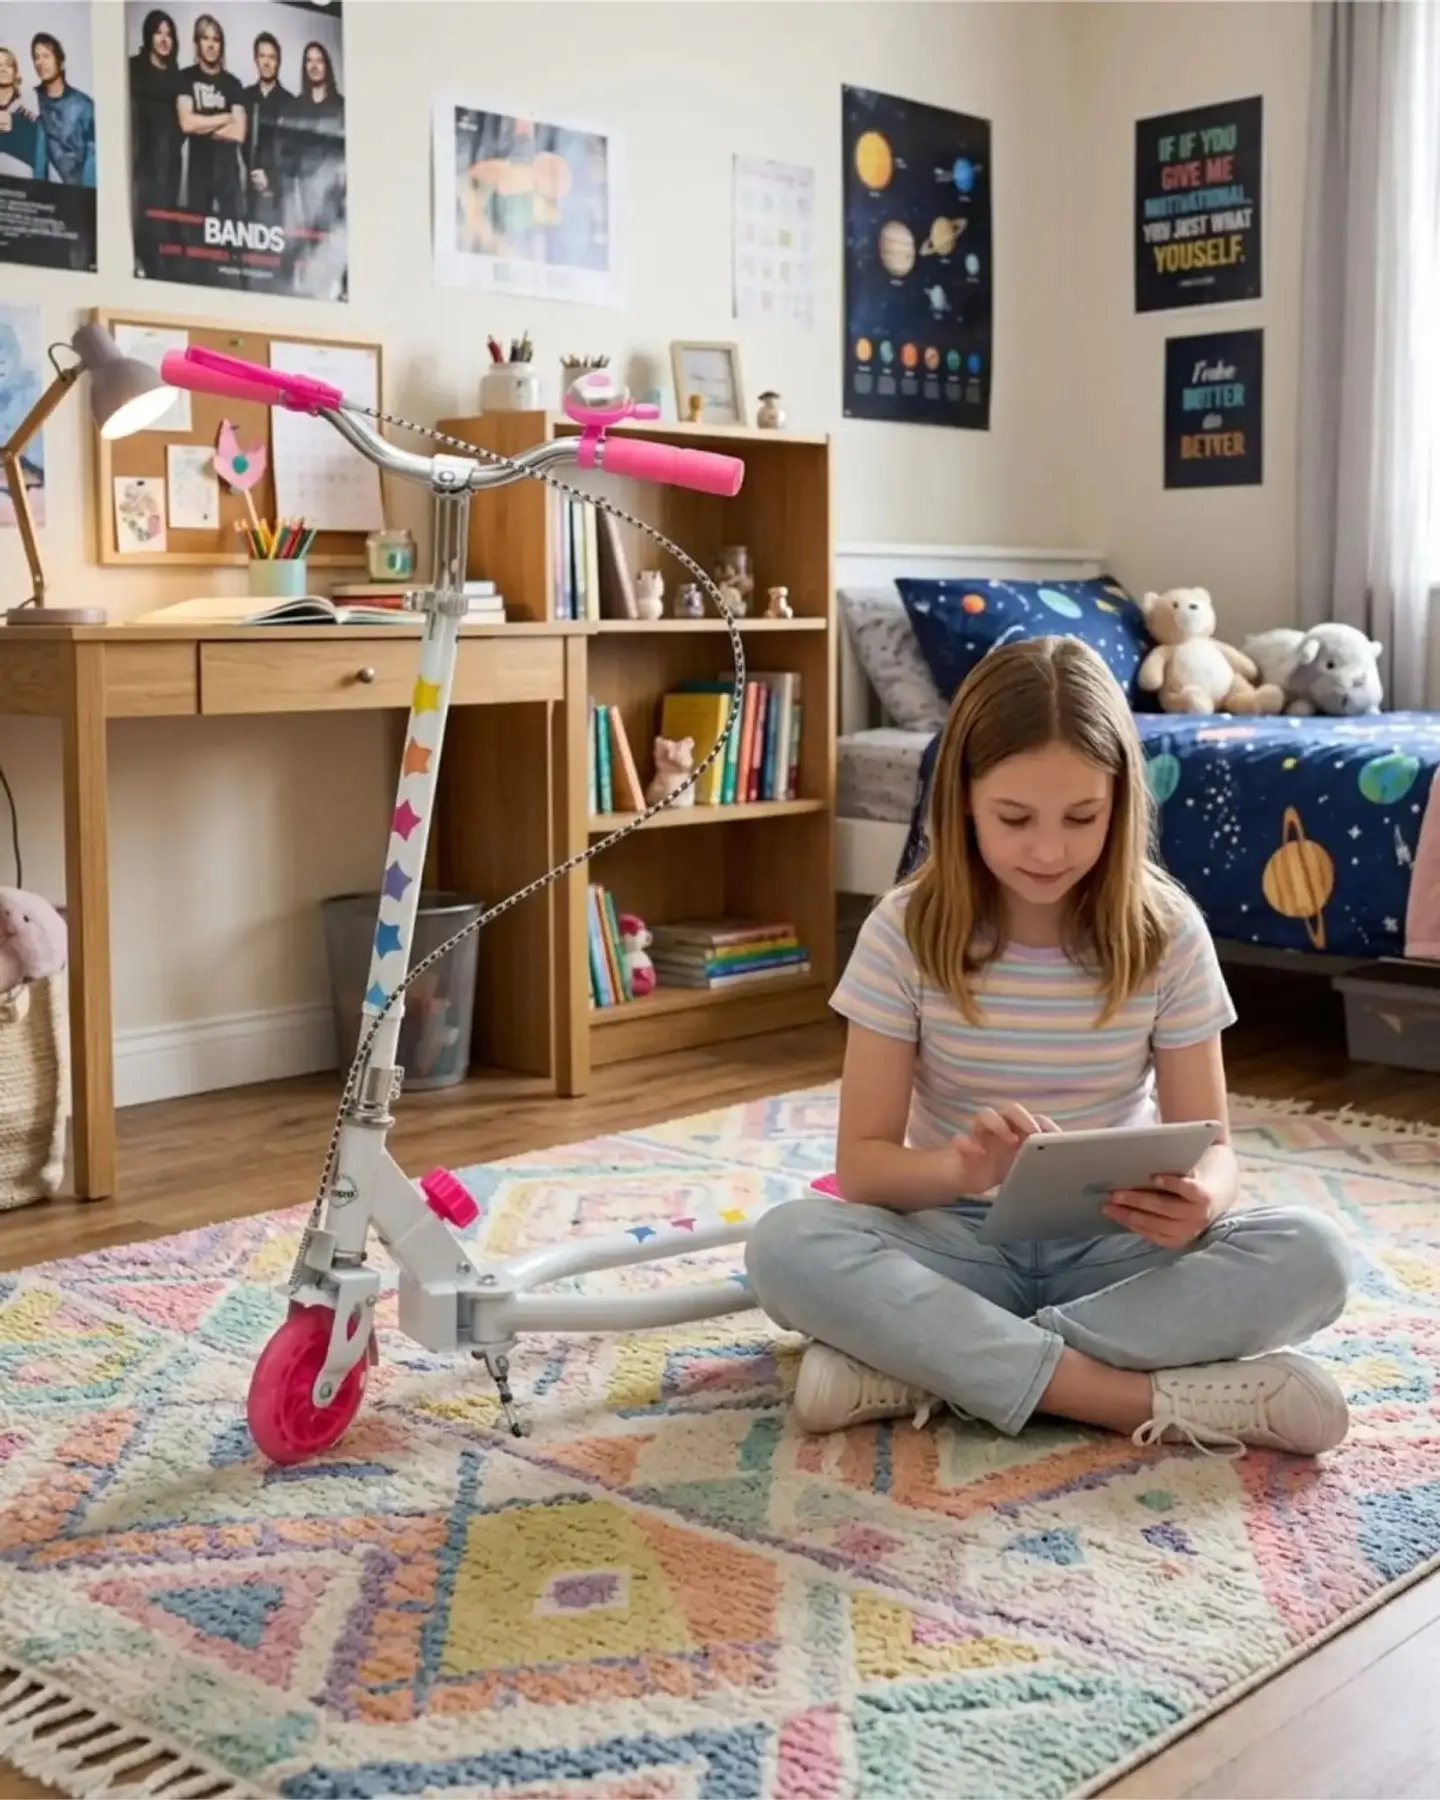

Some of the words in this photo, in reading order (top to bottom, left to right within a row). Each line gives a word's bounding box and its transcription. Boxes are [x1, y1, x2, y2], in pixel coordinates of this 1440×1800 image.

[1158, 135, 1176, 162] IF
[1179, 131, 1197, 159] IF
[1201, 124, 1237, 154] YOU
[1161, 161, 1201, 191] GIVE
[1205, 155, 1235, 184] ME
[204, 216, 286, 252] BANDS
[1210, 208, 1252, 233] WHAT
[1153, 235, 1246, 275] YOUSELF.
